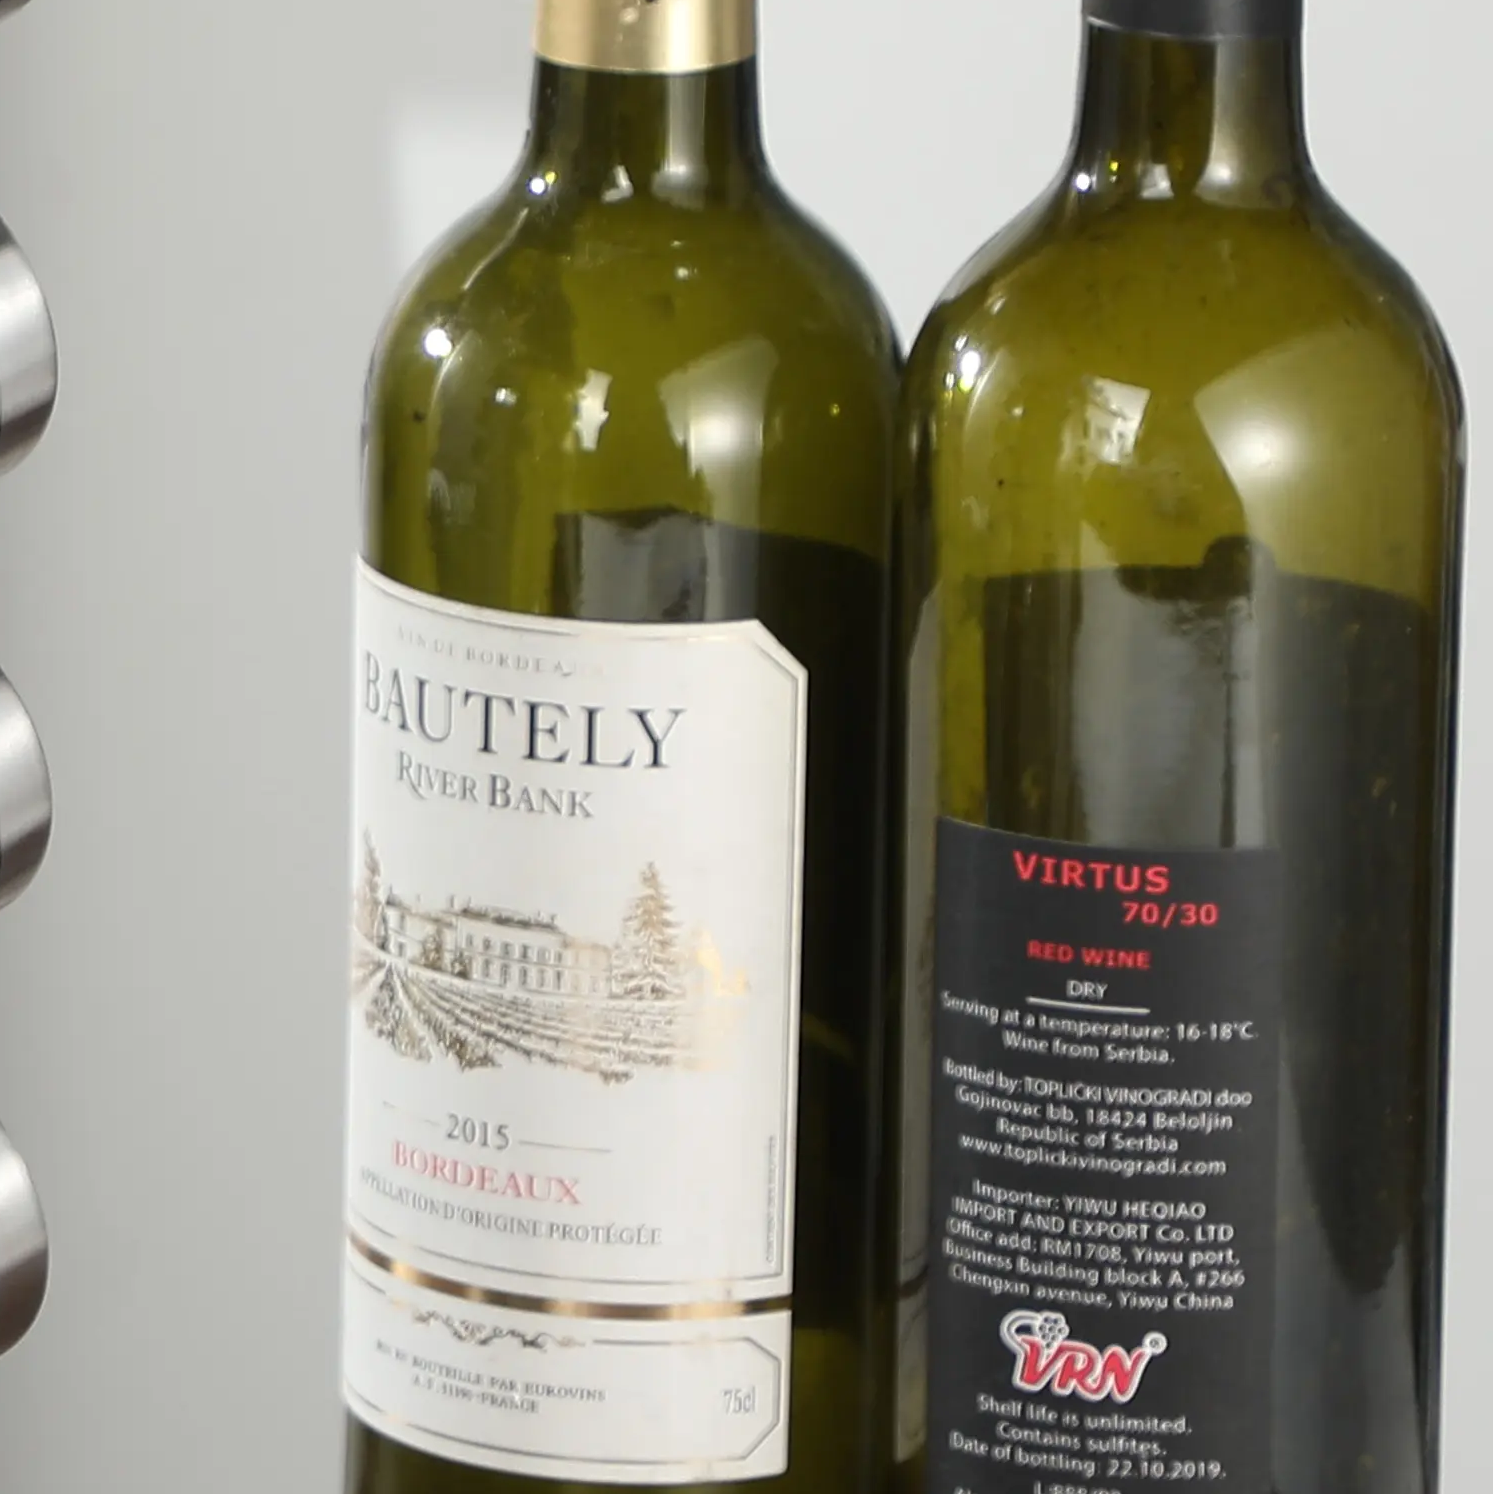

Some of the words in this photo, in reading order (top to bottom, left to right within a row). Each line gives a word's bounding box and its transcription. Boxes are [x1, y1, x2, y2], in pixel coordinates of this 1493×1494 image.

[365, 650, 687, 769] BAUTELY
[1013, 850, 1169, 894] VIRTUS
[1122, 902, 1219, 927] 70/30
[1027, 939, 1073, 964] RED
[1082, 947, 1151, 969] WINE
[1066, 980, 1108, 999] DRY
[941, 991, 999, 1025] Serving
[1003, 1009, 1020, 1027] at
[1024, 1014, 1035, 1028] a
[1039, 1012, 1170, 1041] temperature:
[1002, 1029, 1048, 1052] Wine
[1052, 1036, 1099, 1058] from
[1107, 1044, 1175, 1064] Serbia.
[943, 1056, 993, 1085] Bottled
[997, 1072, 1022, 1094] by:
[1104, 1084, 1211, 1107] VINOGRADI
[1215, 1089, 1253, 1107] doo
[956, 1084, 1041, 1116] Gojinovac
[1086, 1107, 1146, 1128] 18424
[445, 1113, 510, 1150] 2015
[996, 1116, 1078, 1147] Republic
[1084, 1130, 1107, 1147] of
[1113, 1133, 1179, 1153] Serbia
[393, 1139, 582, 1205] BORDEAUX
[959, 1132, 1226, 1178] www.toplickivinogradi.com
[972, 1178, 1059, 1210] Importer:
[1063, 1194, 1116, 1216] YIWU
[951, 1196, 1017, 1225] IMPORT
[1021, 1211, 1065, 1232] AND
[1068, 1218, 1151, 1241] EXPORT
[1156, 1224, 1190, 1243] Co.
[1195, 1224, 1234, 1242] LTD
[943, 1238, 1012, 1270] Business
[1016, 1254, 1099, 1286] Building
[1104, 1264, 1162, 1285] block
[1167, 1269, 1189, 1289] A,
[1194, 1270, 1245, 1288] #266
[946, 1216, 993, 1243] Office
[995, 1233, 1037, 1253] add:
[1131, 1246, 1184, 1265] Yiwu
[1189, 1247, 1241, 1268] port,
[948, 1263, 1029, 1296] Chengxin
[1033, 1284, 1111, 1308] avenue,
[1116, 1290, 1168, 1310] Yiwu
[1173, 1291, 1234, 1310] China
[1012, 1332, 1151, 1404] VRN
[524, 1381, 607, 1402] EUROVINS
[723, 1386, 755, 1414] 75cl
[977, 1393, 1022, 1418] Shelf
[1025, 1402, 1058, 1424] life
[1063, 1408, 1079, 1426] is
[1084, 1413, 1192, 1435] unlimited.
[949, 1430, 988, 1455] Date
[991, 1443, 1014, 1460] of
[1015, 1447, 1100, 1478] bottling:
[996, 1421, 1081, 1450] Contains
[1086, 1434, 1167, 1456] sulfites.
